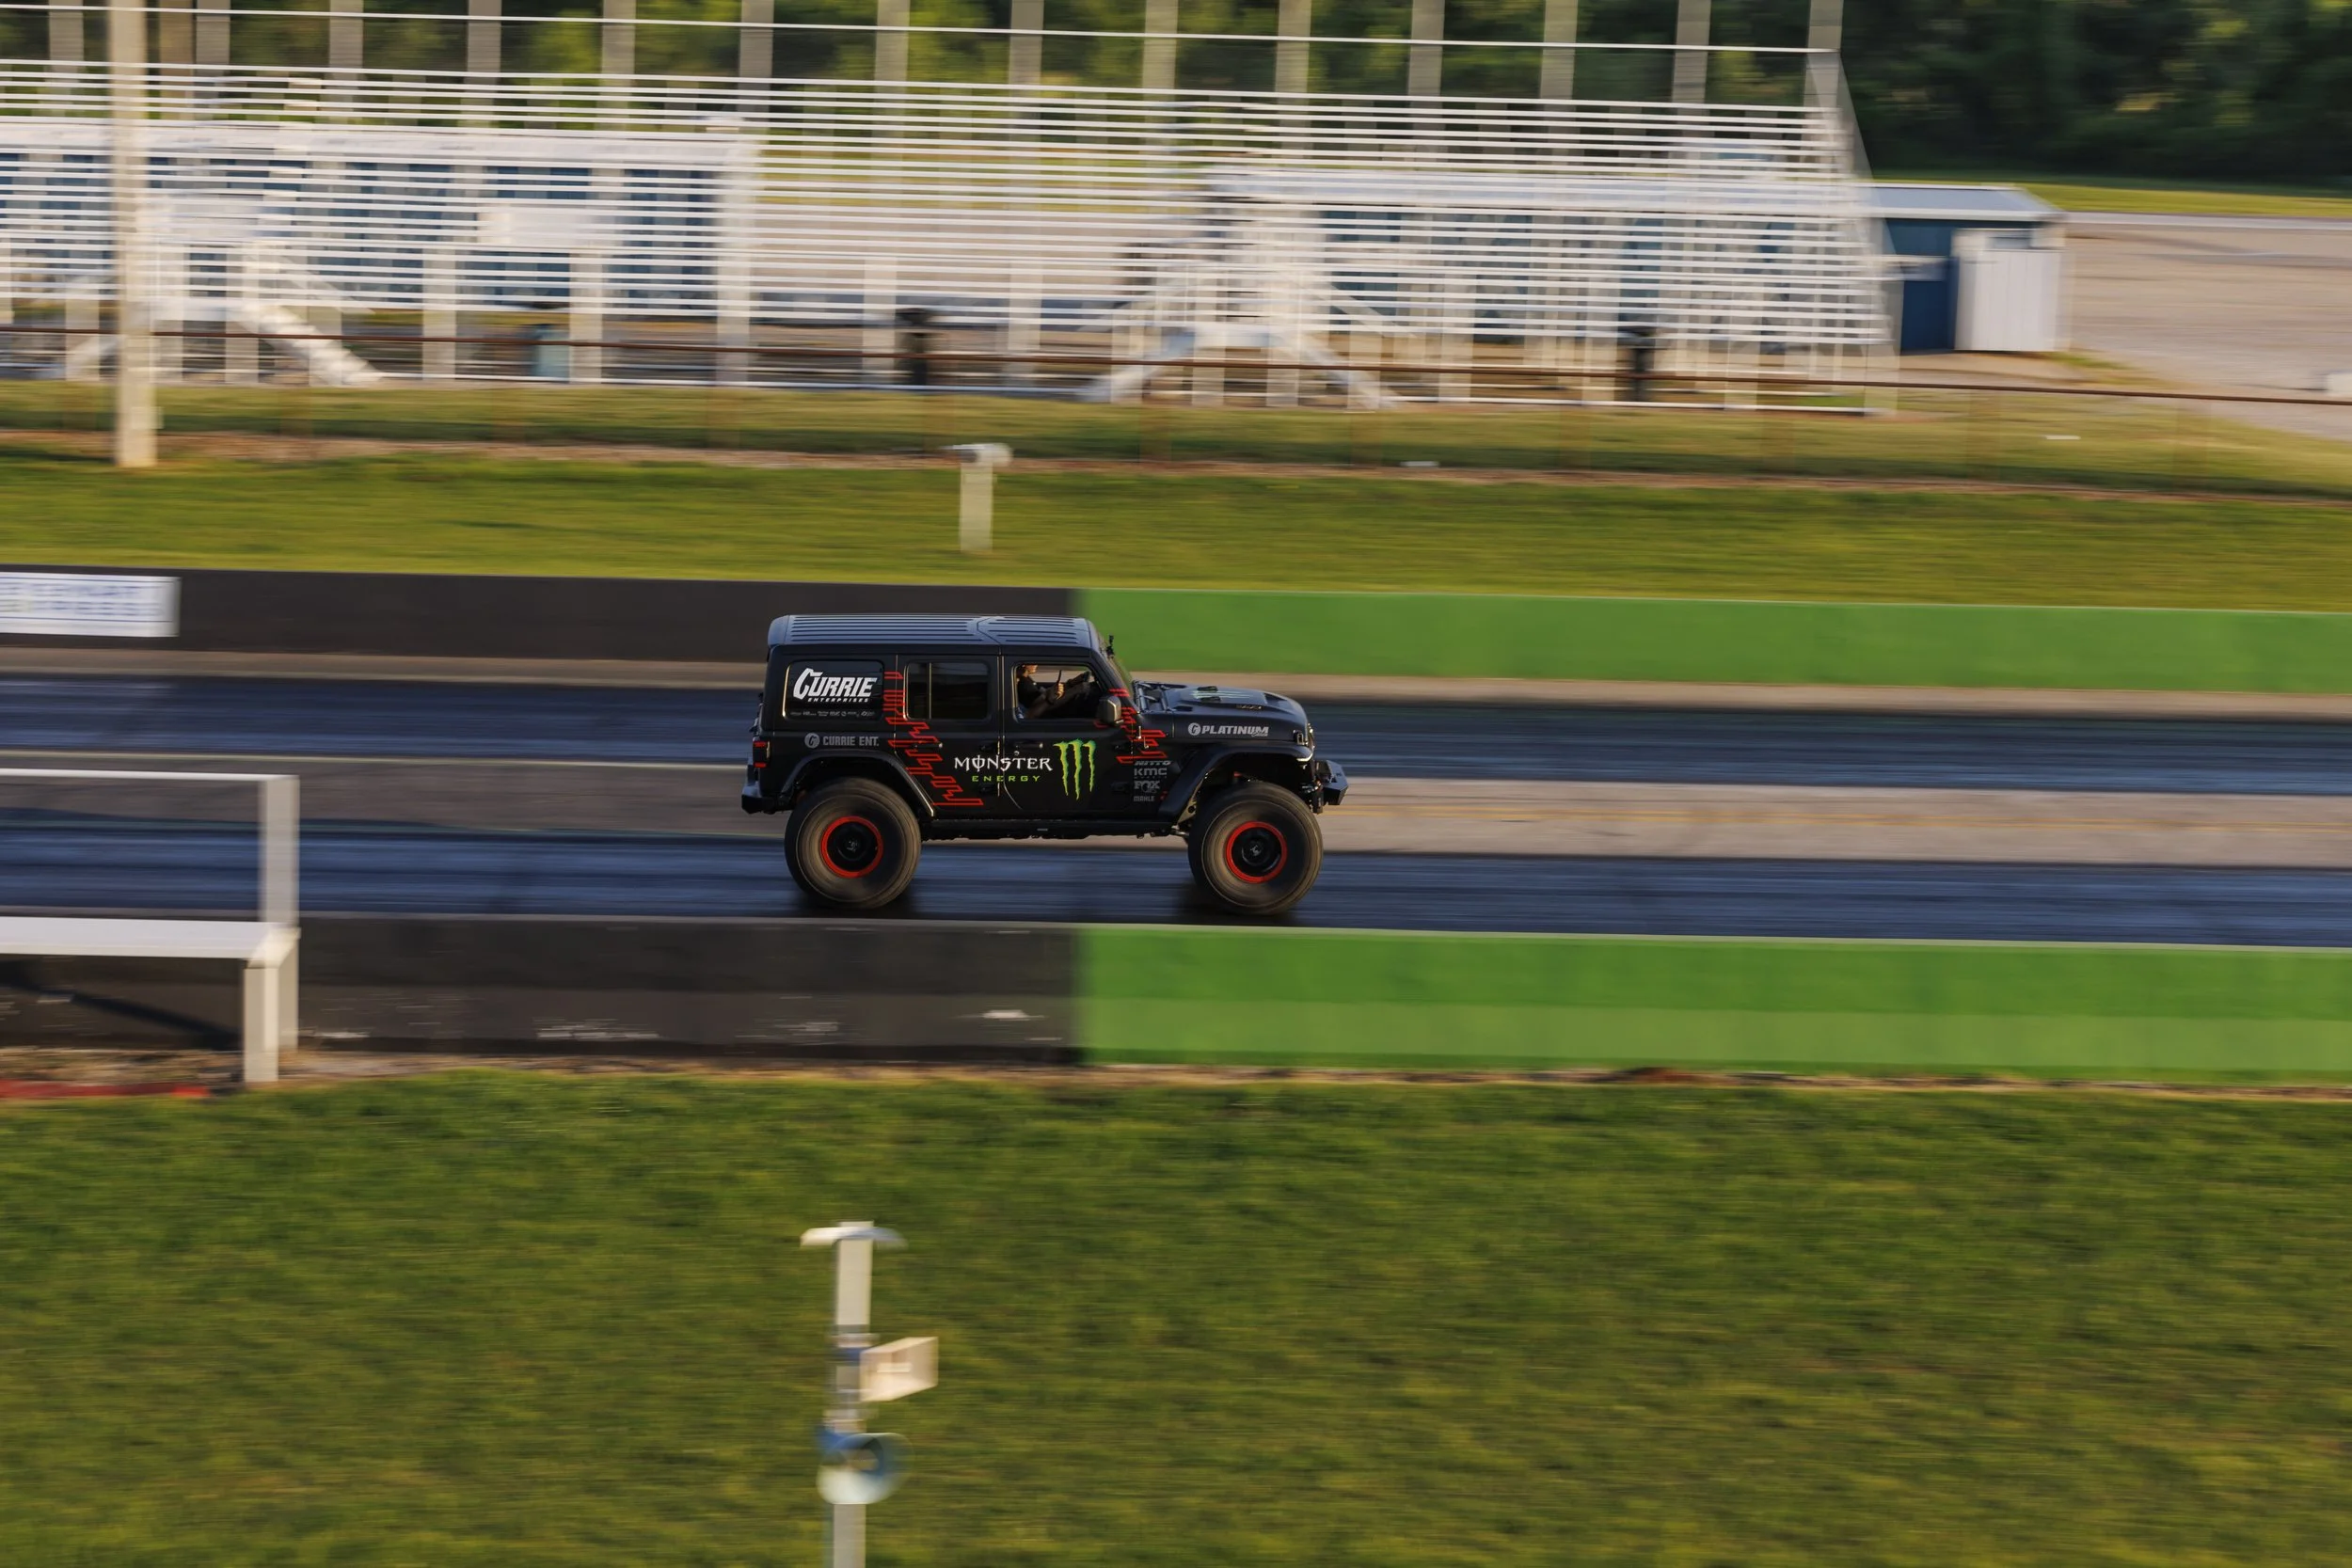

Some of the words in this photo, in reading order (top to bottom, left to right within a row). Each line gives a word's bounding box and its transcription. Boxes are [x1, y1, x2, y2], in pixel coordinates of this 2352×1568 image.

[792, 667, 878, 700] CURRIE
[1201, 725, 1269, 735] PLATINUM
[822, 736, 856, 746] CURRIE
[859, 736, 880, 747] ENT.
[954, 754, 1053, 772] MONSTER
[1134, 780, 1161, 790] FOX
